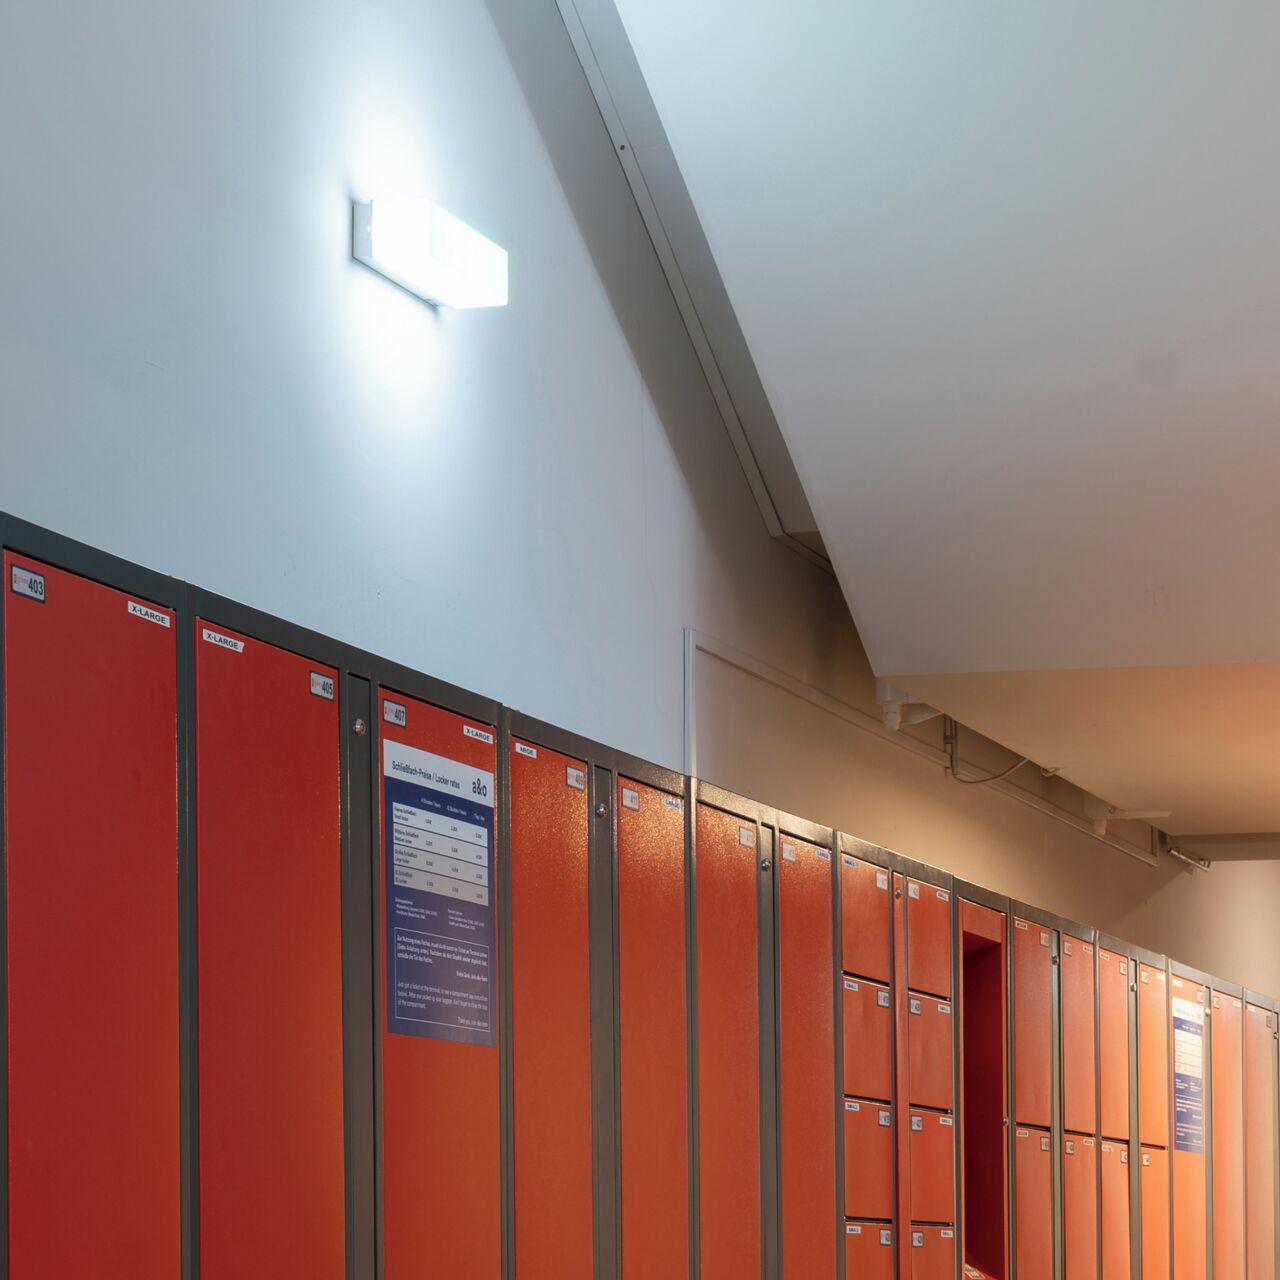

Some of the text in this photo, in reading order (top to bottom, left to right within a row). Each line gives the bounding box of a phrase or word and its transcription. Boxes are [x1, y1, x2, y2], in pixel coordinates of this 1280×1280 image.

[28, 578, 43, 596] 403
[132, 605, 166, 624] X-LARGE
[206, 632, 239, 650] X-LARGE
[322, 680, 333, 695] 405
[466, 727, 490, 741] X-LARGE
[435, 773, 449, 786] Locker
[472, 778, 487, 797] a&o
